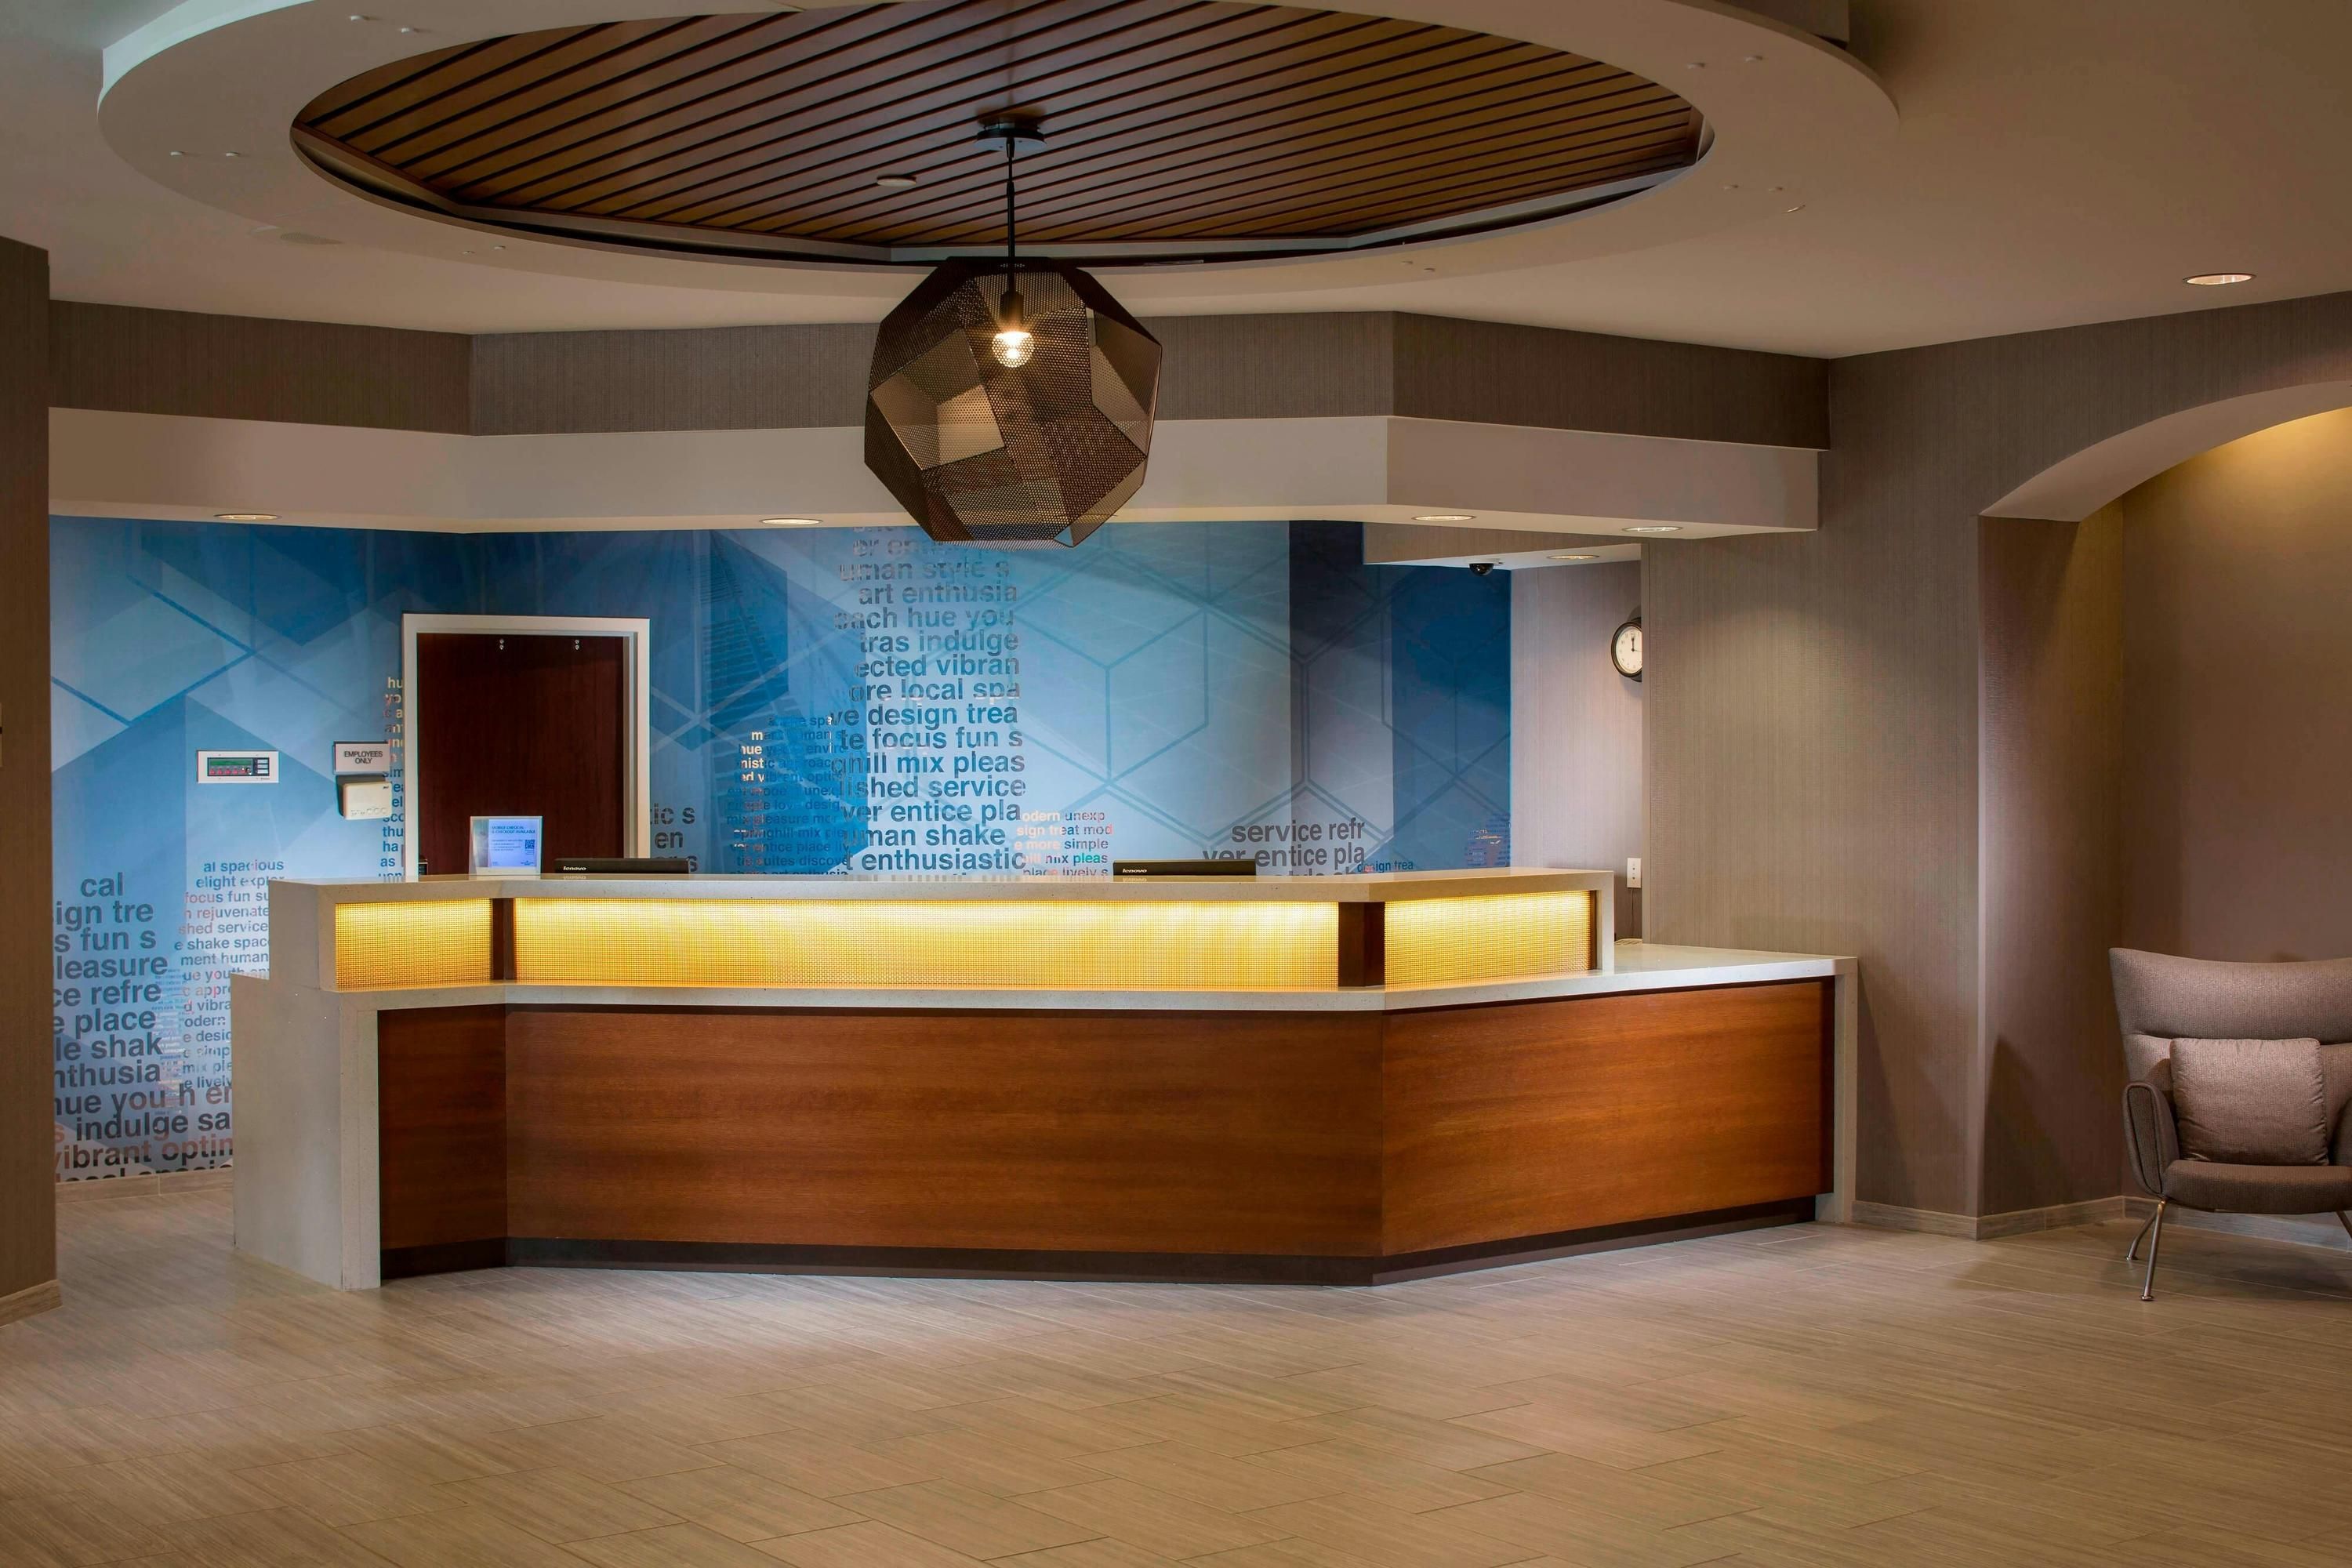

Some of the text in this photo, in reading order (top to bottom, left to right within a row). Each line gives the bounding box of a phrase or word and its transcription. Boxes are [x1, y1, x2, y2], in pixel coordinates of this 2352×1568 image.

[858, 581, 1017, 604] art enthusia
[908, 607, 956, 627] hue
[966, 608, 1014, 631] you
[919, 630, 1019, 656] indulge
[854, 654, 1019, 677] ected vibran
[901, 678, 964, 700] local
[973, 681, 1020, 704] spa
[868, 703, 956, 730] design
[966, 703, 1018, 724] trea
[873, 728, 947, 750] focus
[956, 726, 999, 748] fun
[1008, 730, 1023, 747] s
[898, 751, 945, 773] mix
[954, 750, 1025, 778] pleas
[927, 775, 1026, 797] service
[682, 807, 695, 825] s
[841, 799, 1021, 826] ver entice pla
[1065, 811, 1105, 823] unexp
[655, 830, 684, 849] en
[925, 824, 1006, 847] shake
[1016, 825, 1045, 837] sign
[1083, 823, 1114, 835] mod
[1232, 817, 1366, 843] service refr
[1064, 838, 1109, 851] simple
[1254, 845, 1327, 867] entice
[1334, 842, 1365, 870] pla
[204, 859, 285, 874] al spacious
[380, 858, 395, 867] as
[862, 847, 1027, 870] enthusiastic
[1073, 852, 1109, 866] pleas
[81, 872, 123, 897] cal
[196, 876, 236, 890] elight
[185, 891, 223, 903] focus
[227, 890, 250, 902] fun
[114, 901, 154, 924] tre
[198, 906, 269, 921] rejuvenate
[179, 920, 268, 935] shed service
[54, 927, 157, 953] s fun s
[174, 941, 183, 950] e
[187, 938, 230, 950] shake
[180, 953, 269, 966] ment human
[91, 980, 162, 1004] refre
[75, 1008, 156, 1039] place
[91, 1032, 162, 1058] shak
[76, 1112, 188, 1141] indulge
[198, 1111, 230, 1132] sa
